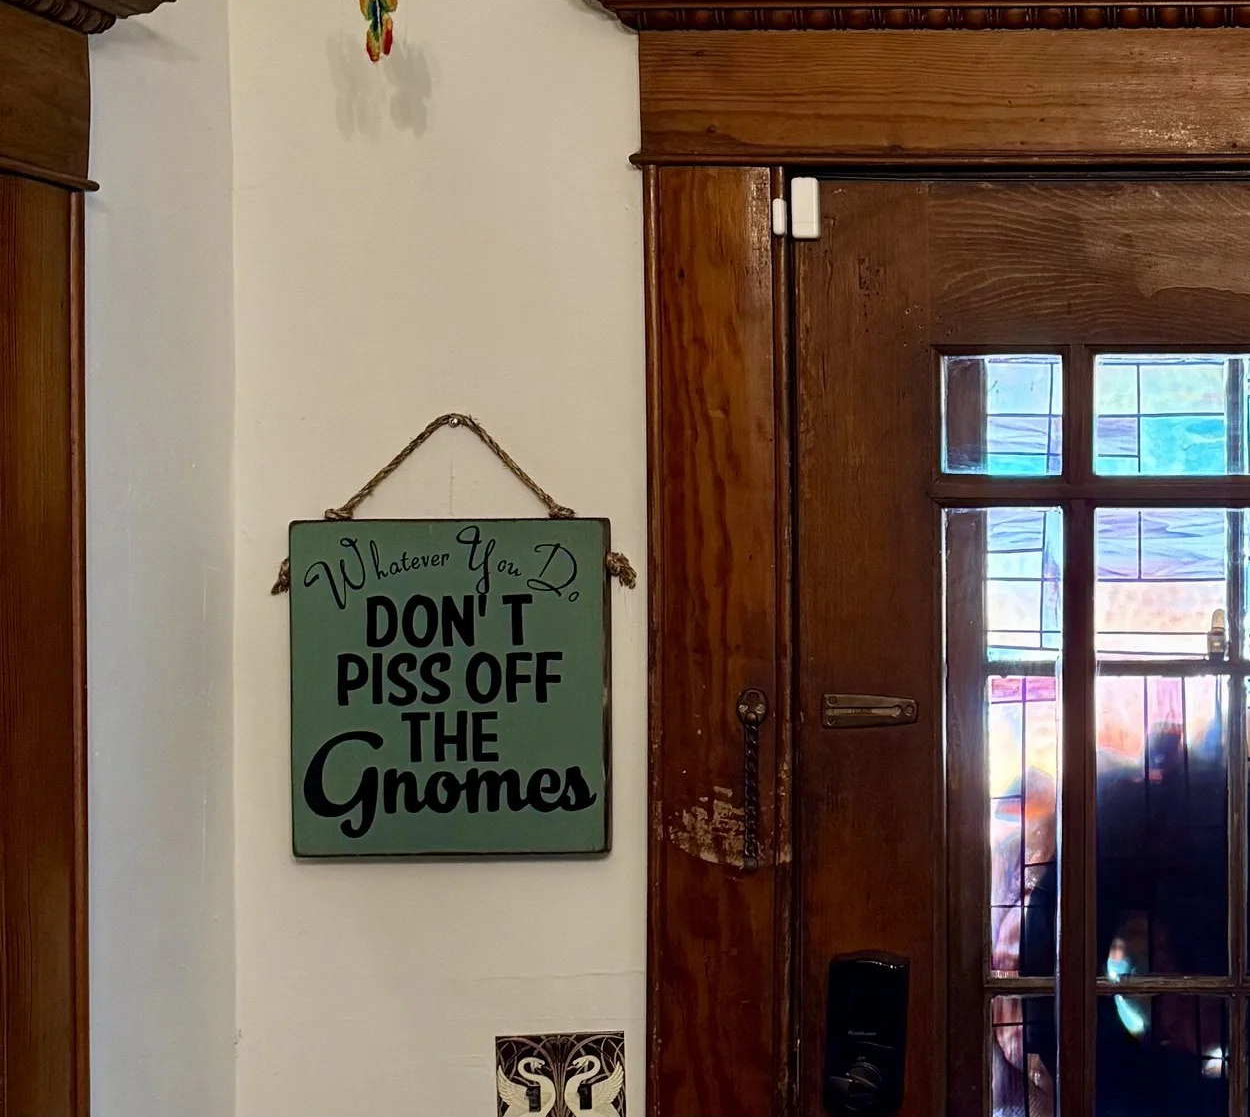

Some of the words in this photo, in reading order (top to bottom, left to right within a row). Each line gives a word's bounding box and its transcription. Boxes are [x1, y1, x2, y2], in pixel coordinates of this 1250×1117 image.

[303, 537, 450, 610] Whatever
[456, 525, 522, 595] You
[526, 542, 579, 603] Do
[366, 593, 533, 648] DON'T
[337, 652, 452, 707] PISS
[465, 651, 564, 704] OFF
[400, 711, 499, 763] THE
[303, 731, 598, 839] Gnomes
